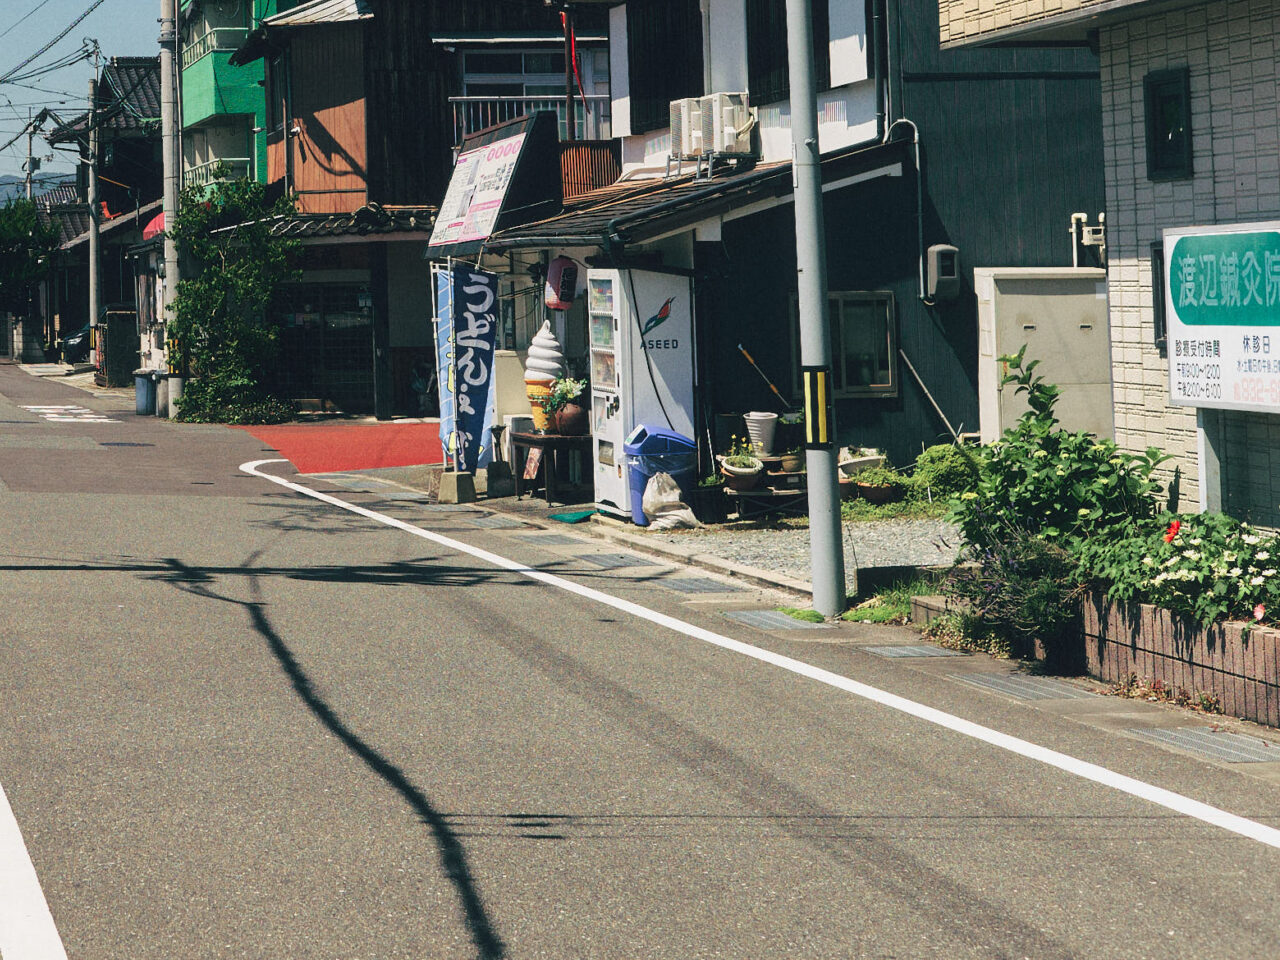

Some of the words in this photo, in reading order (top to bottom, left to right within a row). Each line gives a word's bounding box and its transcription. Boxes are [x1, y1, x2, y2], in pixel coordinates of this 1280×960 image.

[640, 339, 679, 349] ASEED
[1175, 339, 1220, 358] 診療受付時間
[1242, 335, 1270, 353] 休診日
